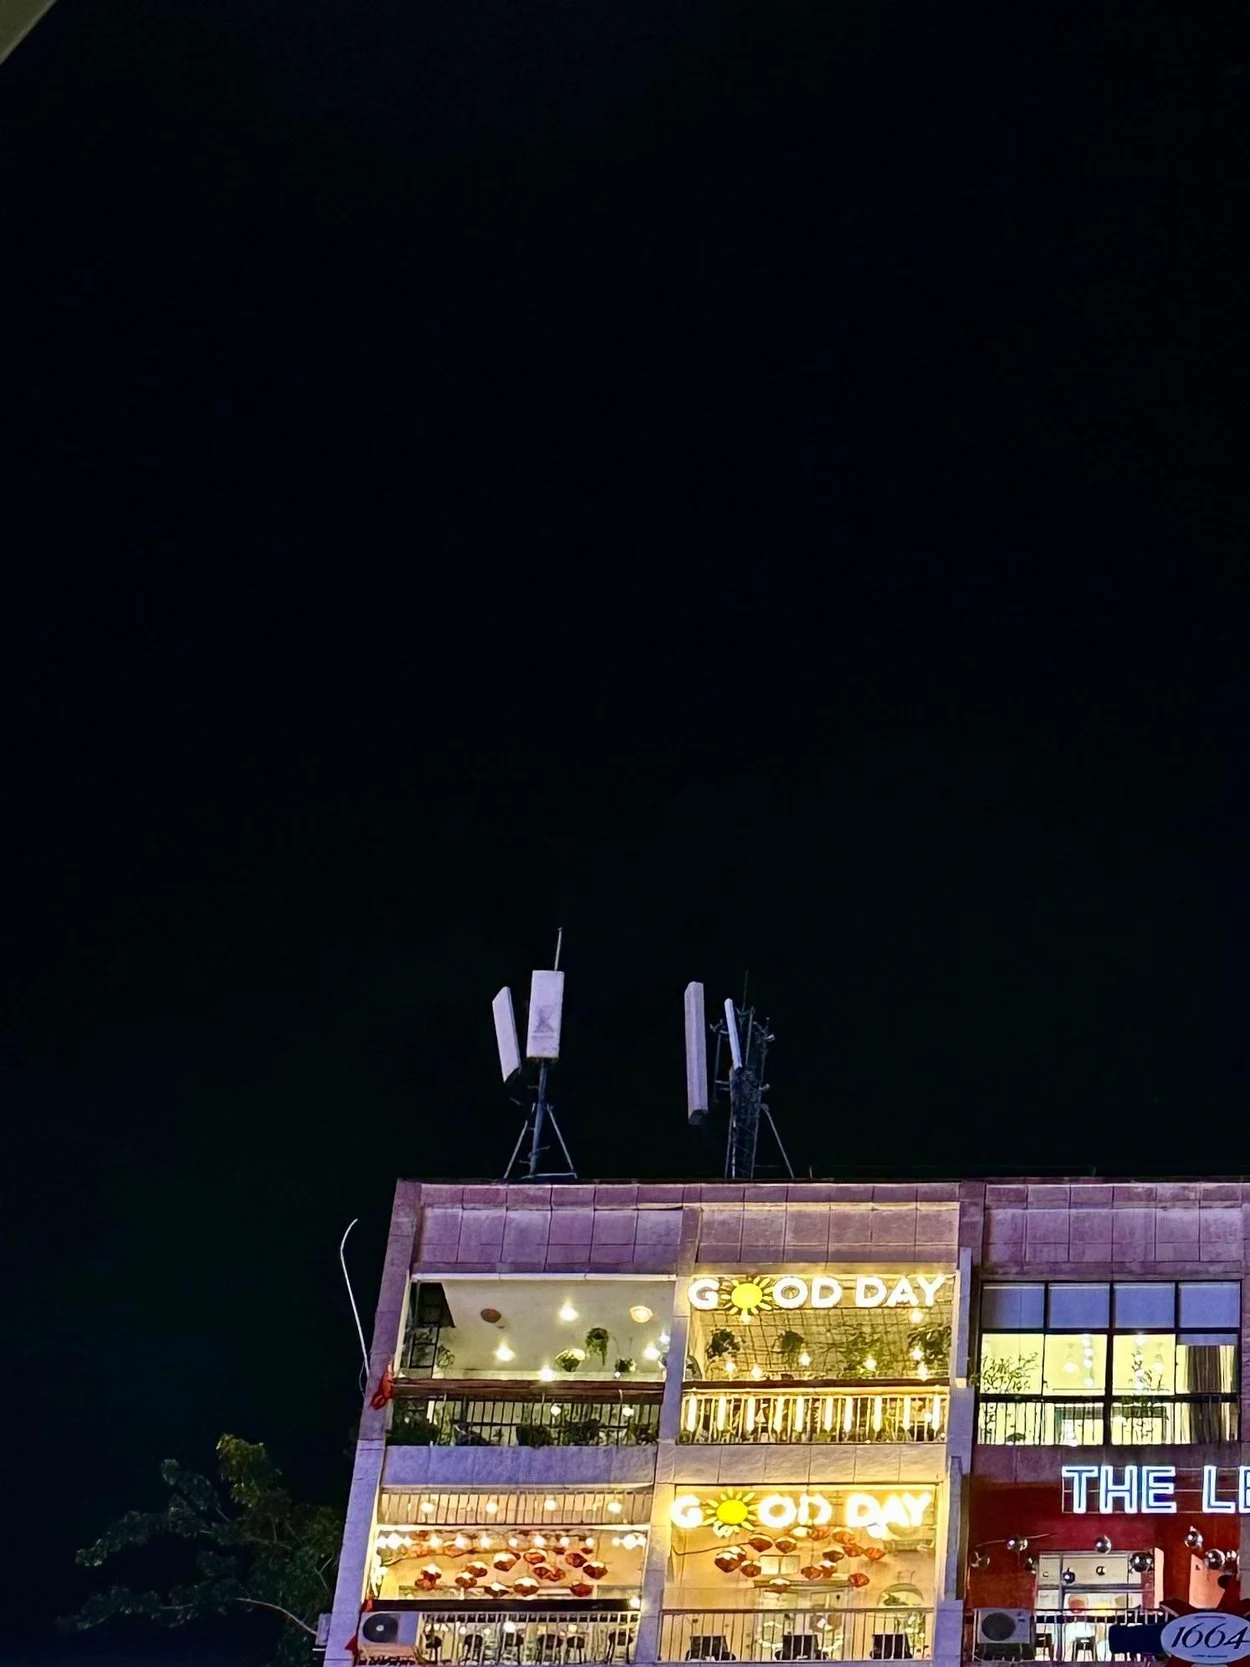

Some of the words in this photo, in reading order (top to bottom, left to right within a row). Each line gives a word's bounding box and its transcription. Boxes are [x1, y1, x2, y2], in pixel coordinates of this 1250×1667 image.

[854, 1275, 944, 1307] DAY
[1062, 1464, 1177, 1513] THE
[846, 1494, 933, 1528] DAY
